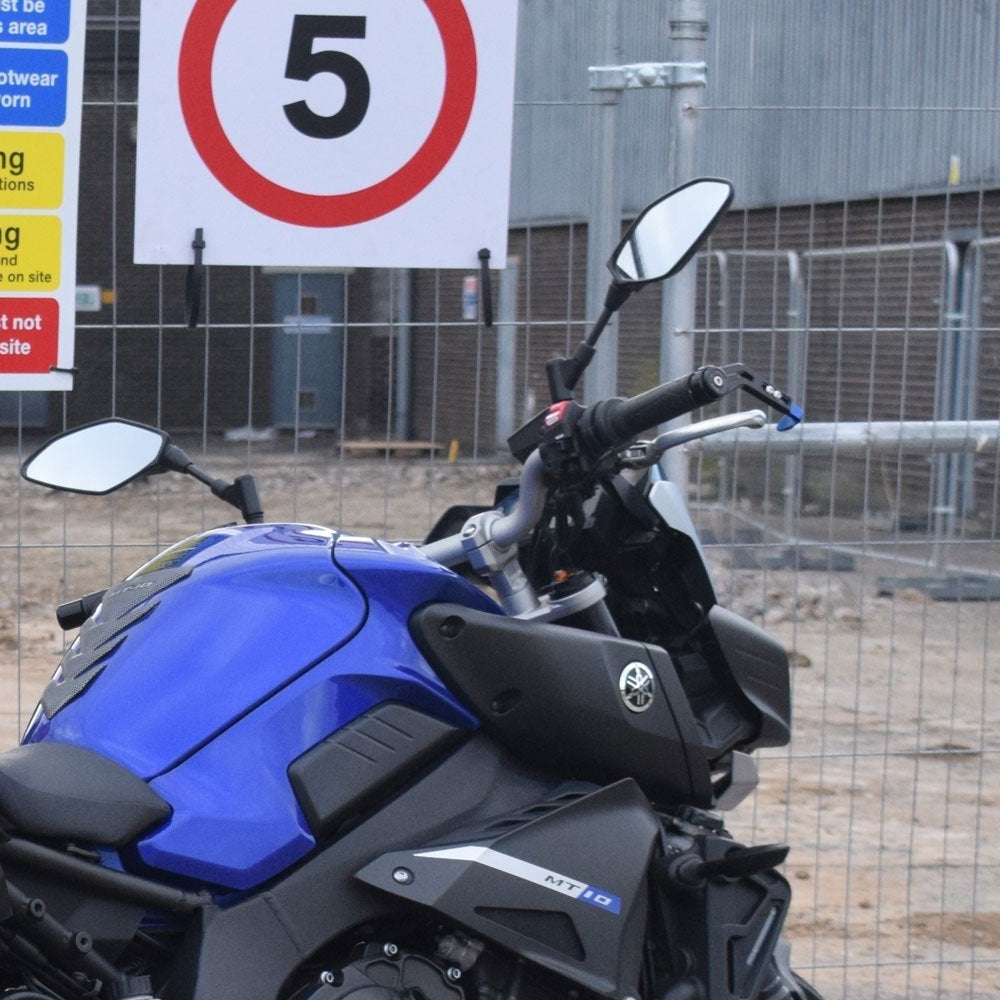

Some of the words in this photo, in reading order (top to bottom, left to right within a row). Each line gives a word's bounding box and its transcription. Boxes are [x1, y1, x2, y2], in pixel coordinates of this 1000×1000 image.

[8, 22, 47, 35] area
[282, 14, 371, 139] 5
[8, 274, 24, 282] on
[29, 272, 51, 282] site
[13, 315, 41, 330] not
[0, 339, 31, 355] site
